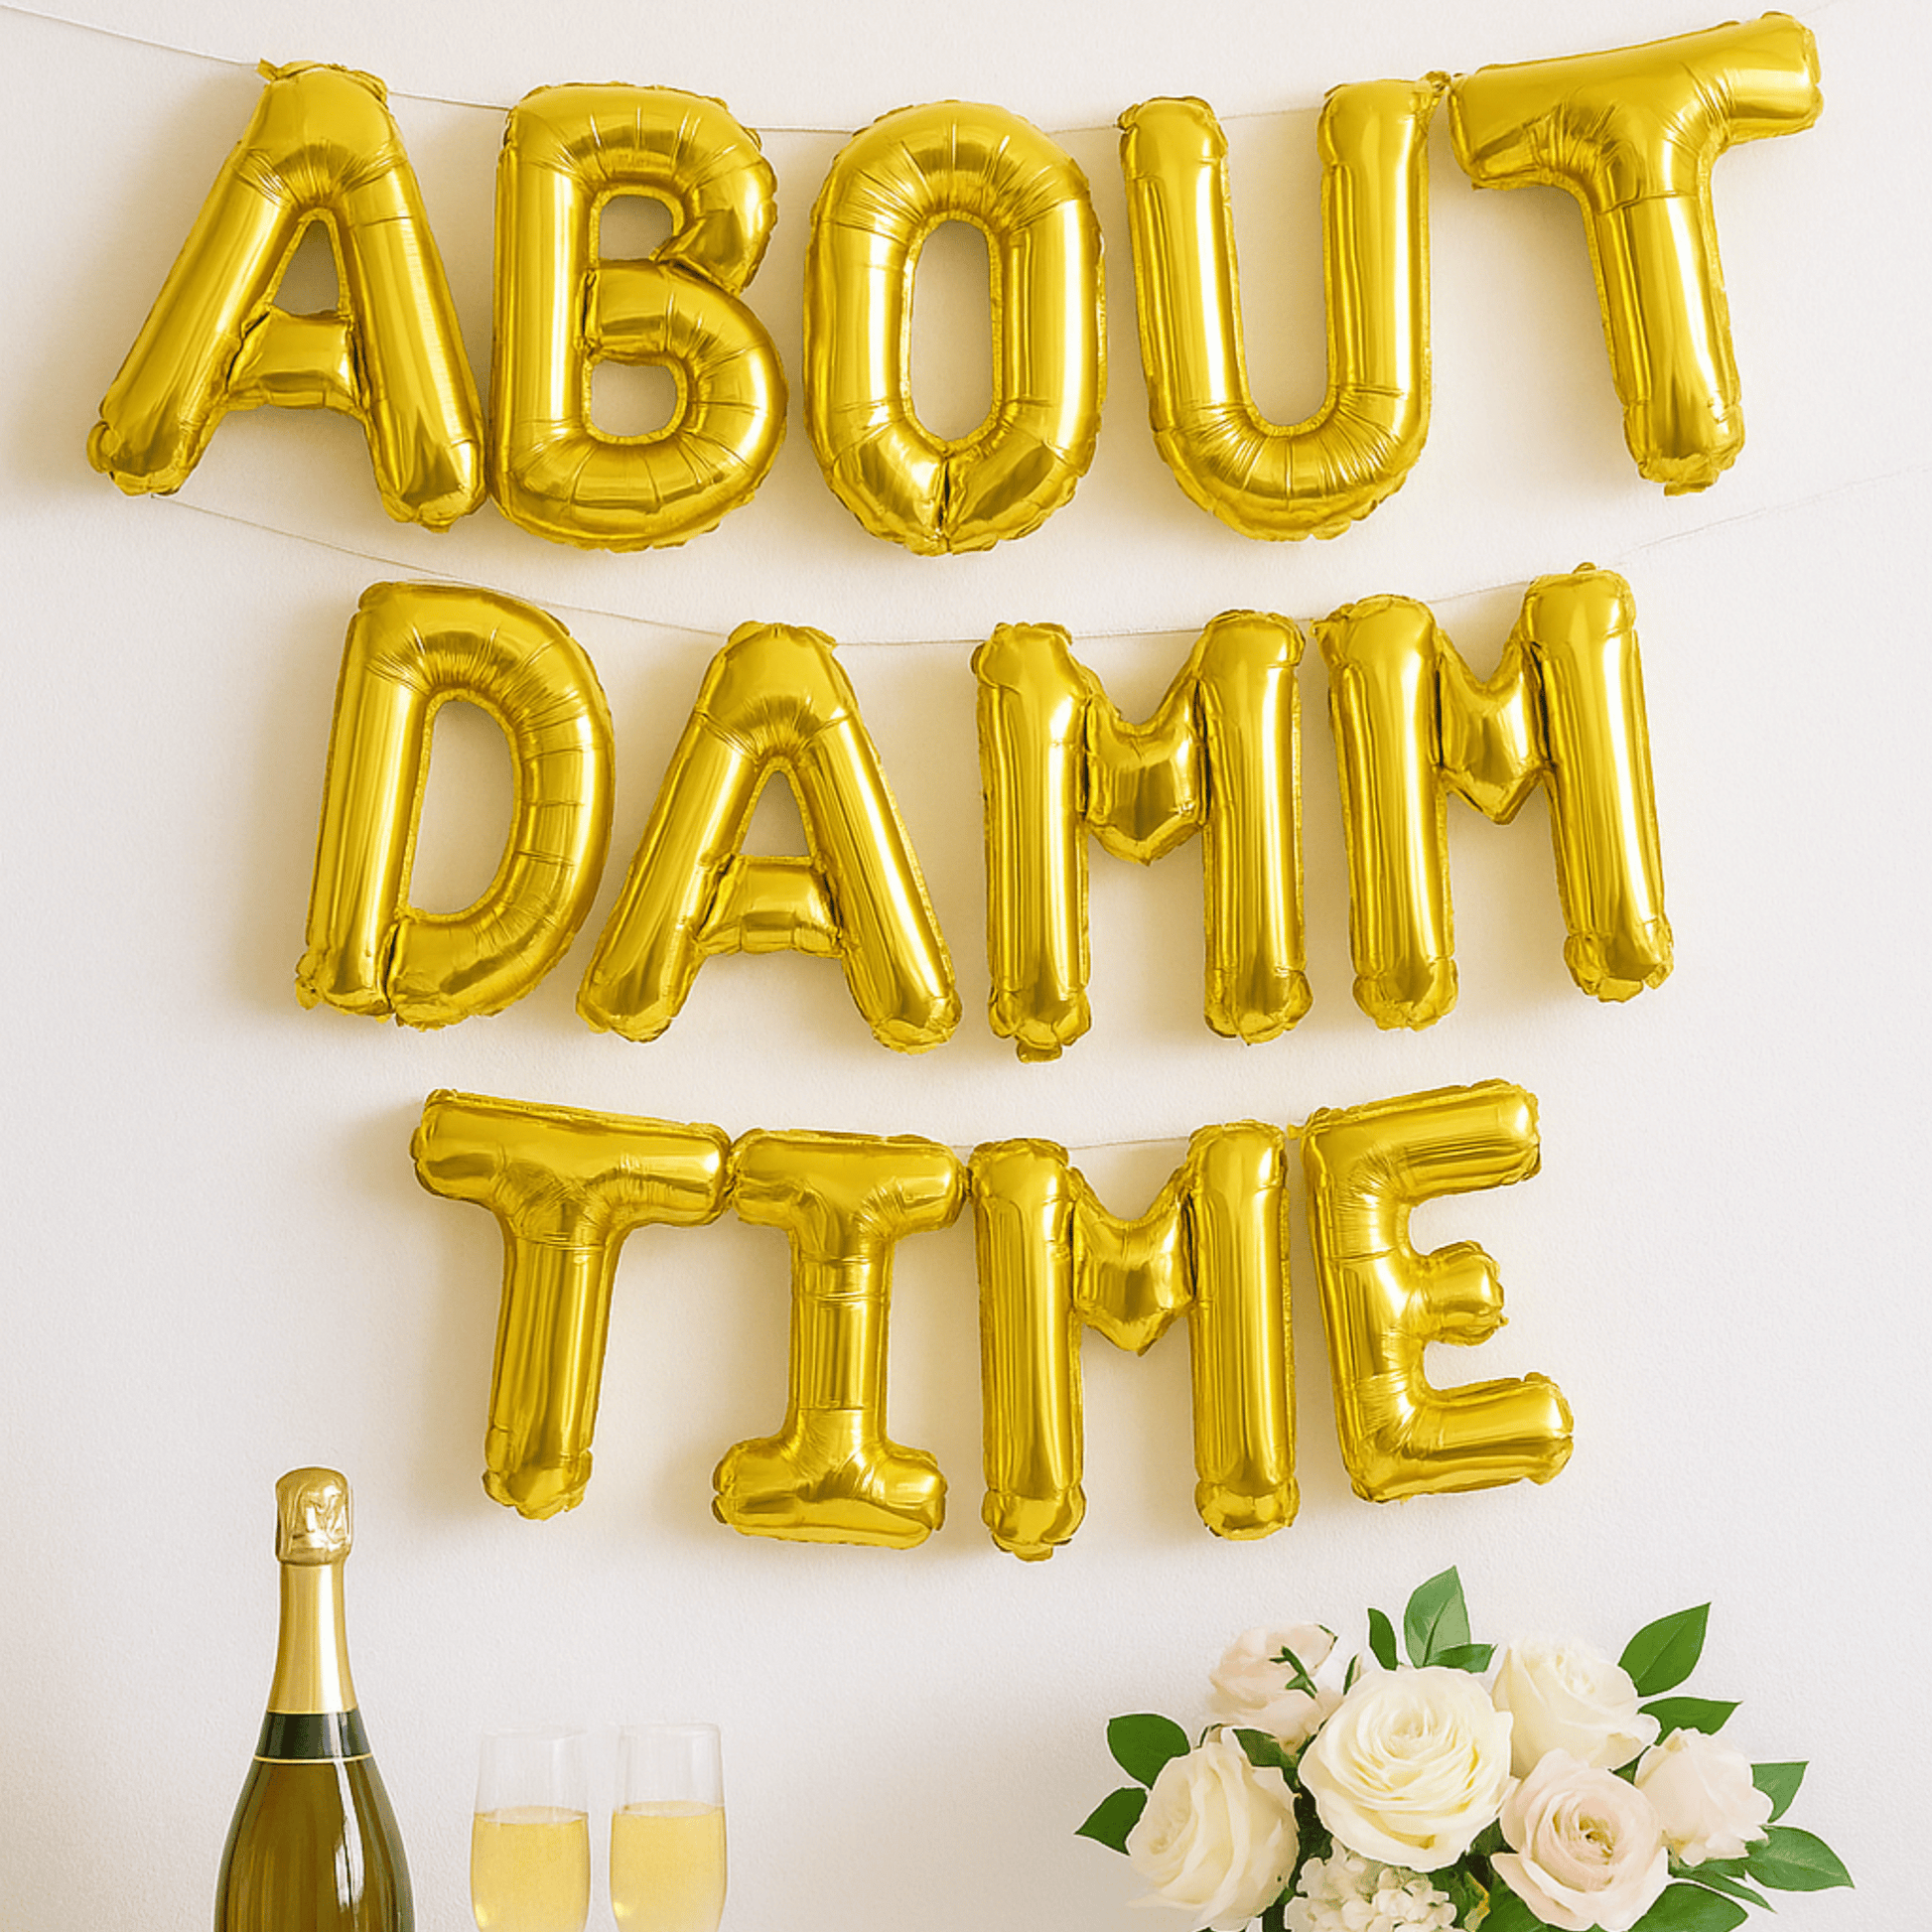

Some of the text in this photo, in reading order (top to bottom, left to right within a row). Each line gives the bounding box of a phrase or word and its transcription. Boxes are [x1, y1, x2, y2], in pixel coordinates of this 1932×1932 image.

[85, 12, 1823, 556] ABOUT
[294, 563, 1674, 1063] DAMM
[408, 1079, 1574, 1563] TIME
